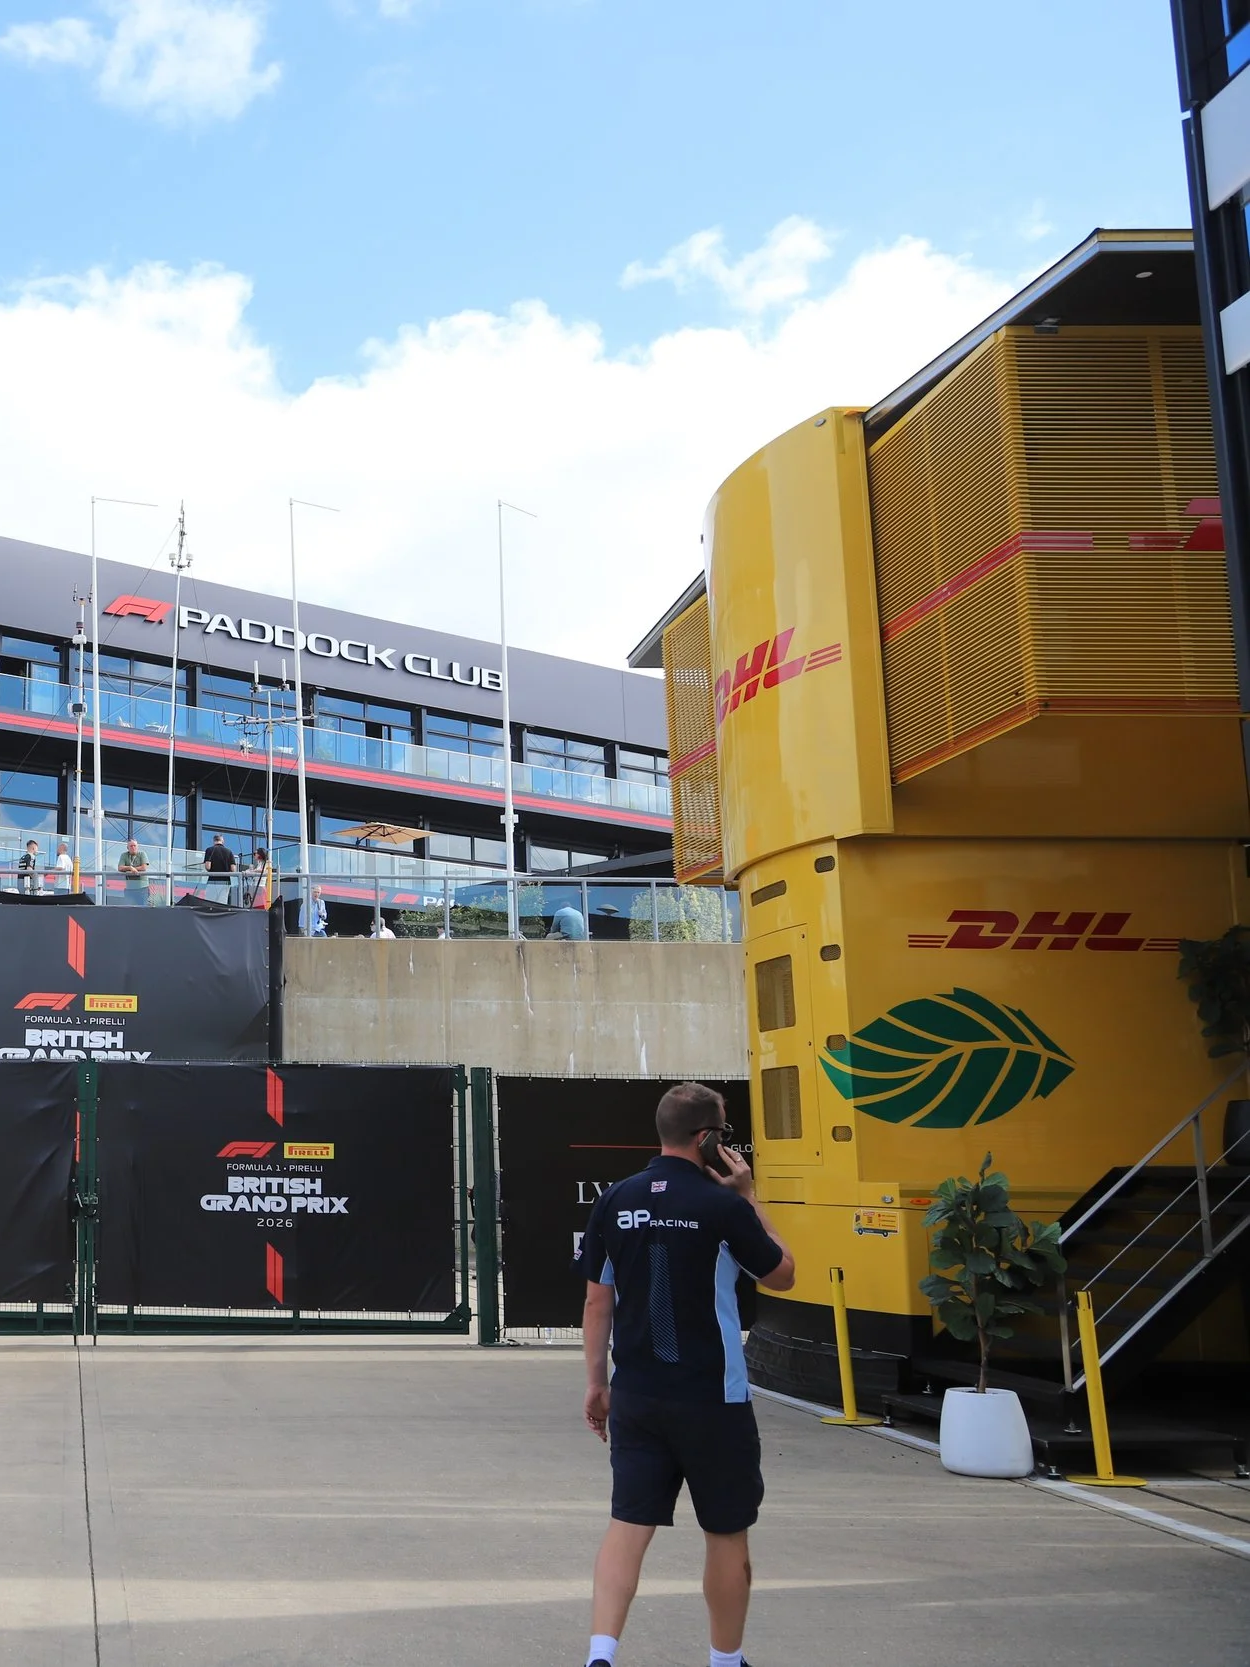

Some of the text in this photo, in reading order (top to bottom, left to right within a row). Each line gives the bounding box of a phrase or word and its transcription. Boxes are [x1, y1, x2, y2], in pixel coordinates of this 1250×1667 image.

[179, 605, 398, 670] PADDOCK
[404, 653, 504, 692] CLUB
[715, 627, 807, 730] DHL
[945, 910, 1145, 951] DHL
[89, 998, 133, 1009] PIRELLI
[24, 1015, 126, 1026] FORMULA 1 PIRELLI
[25, 1028, 124, 1049] BRITISH
[287, 1145, 330, 1156] PIRELLI
[730, 1143, 754, 1153] GLO
[226, 1163, 324, 1173] FORMULA 1 PIRELLI
[227, 1176, 322, 1195] BRITISH
[575, 1181, 612, 1204] LV
[200, 1194, 350, 1214] GRAND PRIX
[256, 1217, 293, 1228] 2026
[650, 1219, 699, 1229] RACING
